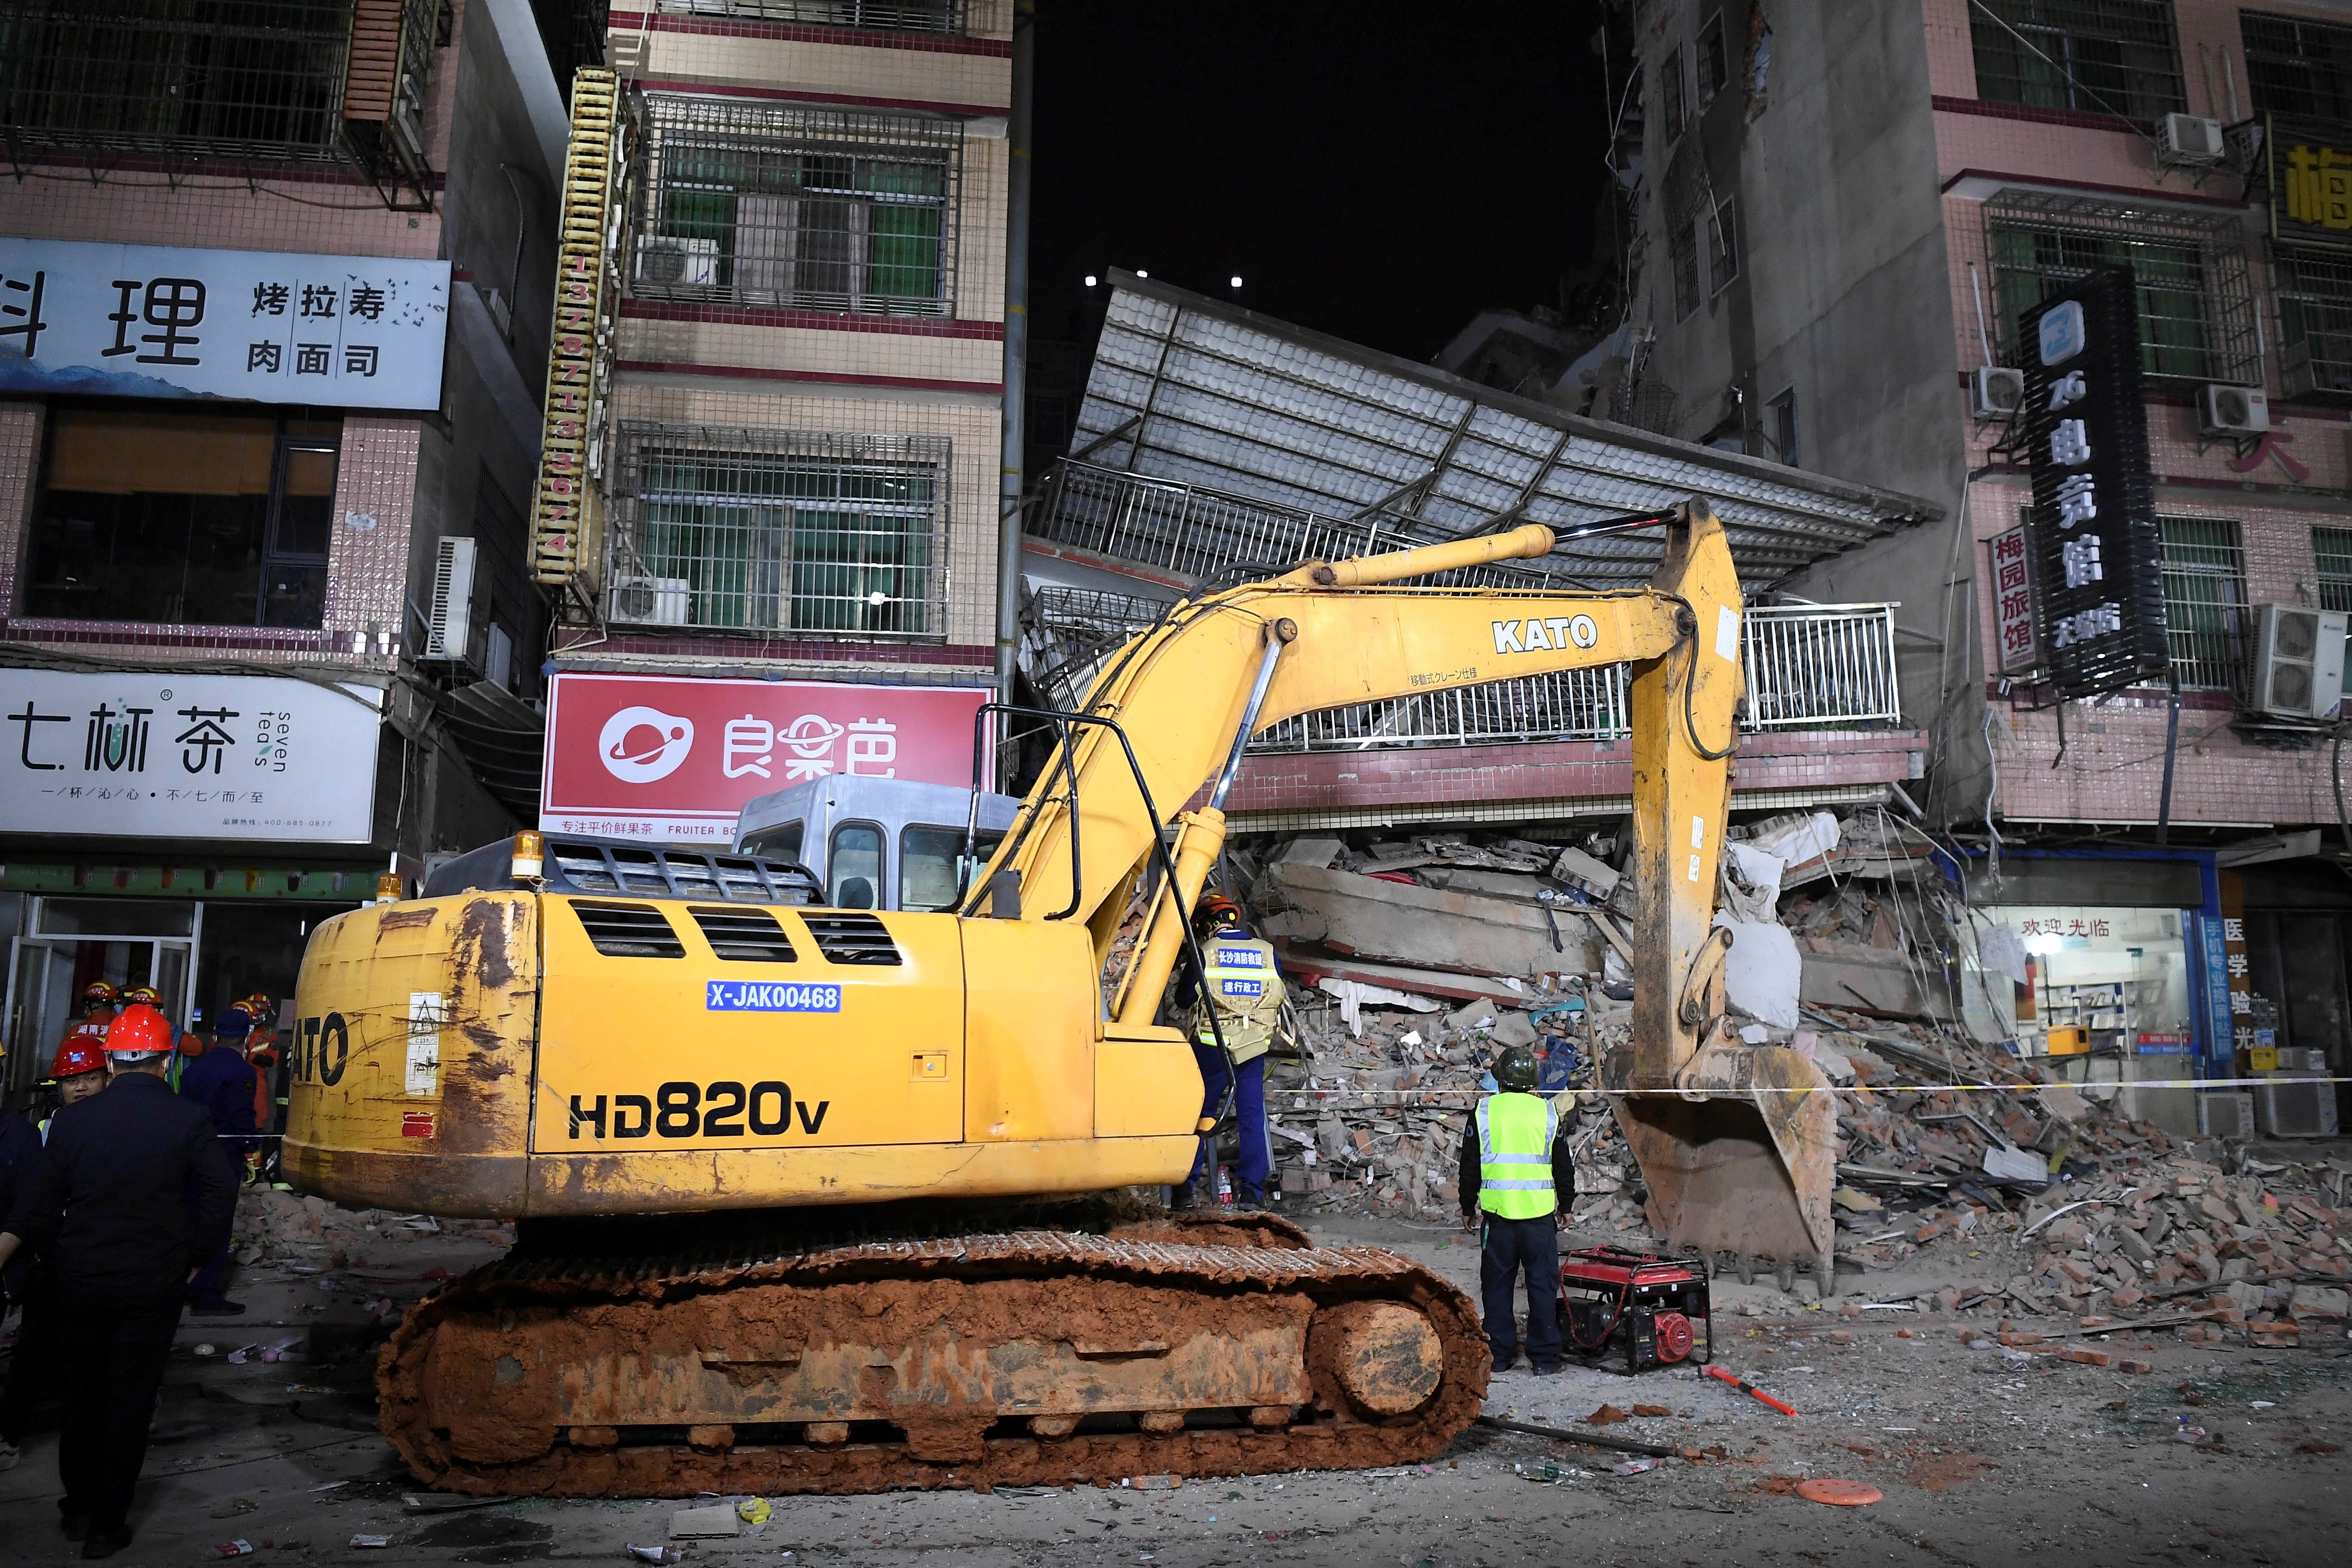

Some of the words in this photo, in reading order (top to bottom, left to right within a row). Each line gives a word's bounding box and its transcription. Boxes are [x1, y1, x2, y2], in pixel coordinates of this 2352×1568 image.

[246, 282, 289, 373] 烤肉
[295, 284, 337, 376] 拉面
[344, 287, 385, 377] 寿司
[1996, 533, 2032, 651] 梅园旅馆
[1492, 614, 1598, 654] KATO
[1410, 667, 1478, 687] 移動式クレーン仕様
[273, 712, 290, 773] seven
[723, 714, 897, 780] 良果芭
[562, 820, 653, 836] 专注平价鲜果茶
[668, 825, 714, 835] FRUITEA
[1219, 950, 1262, 965] 长沙消防救援
[2021, 918, 2110, 937] 欢迎光临
[711, 983, 837, 1008] X-JAK00468
[2224, 918, 2255, 1050] 医学验光
